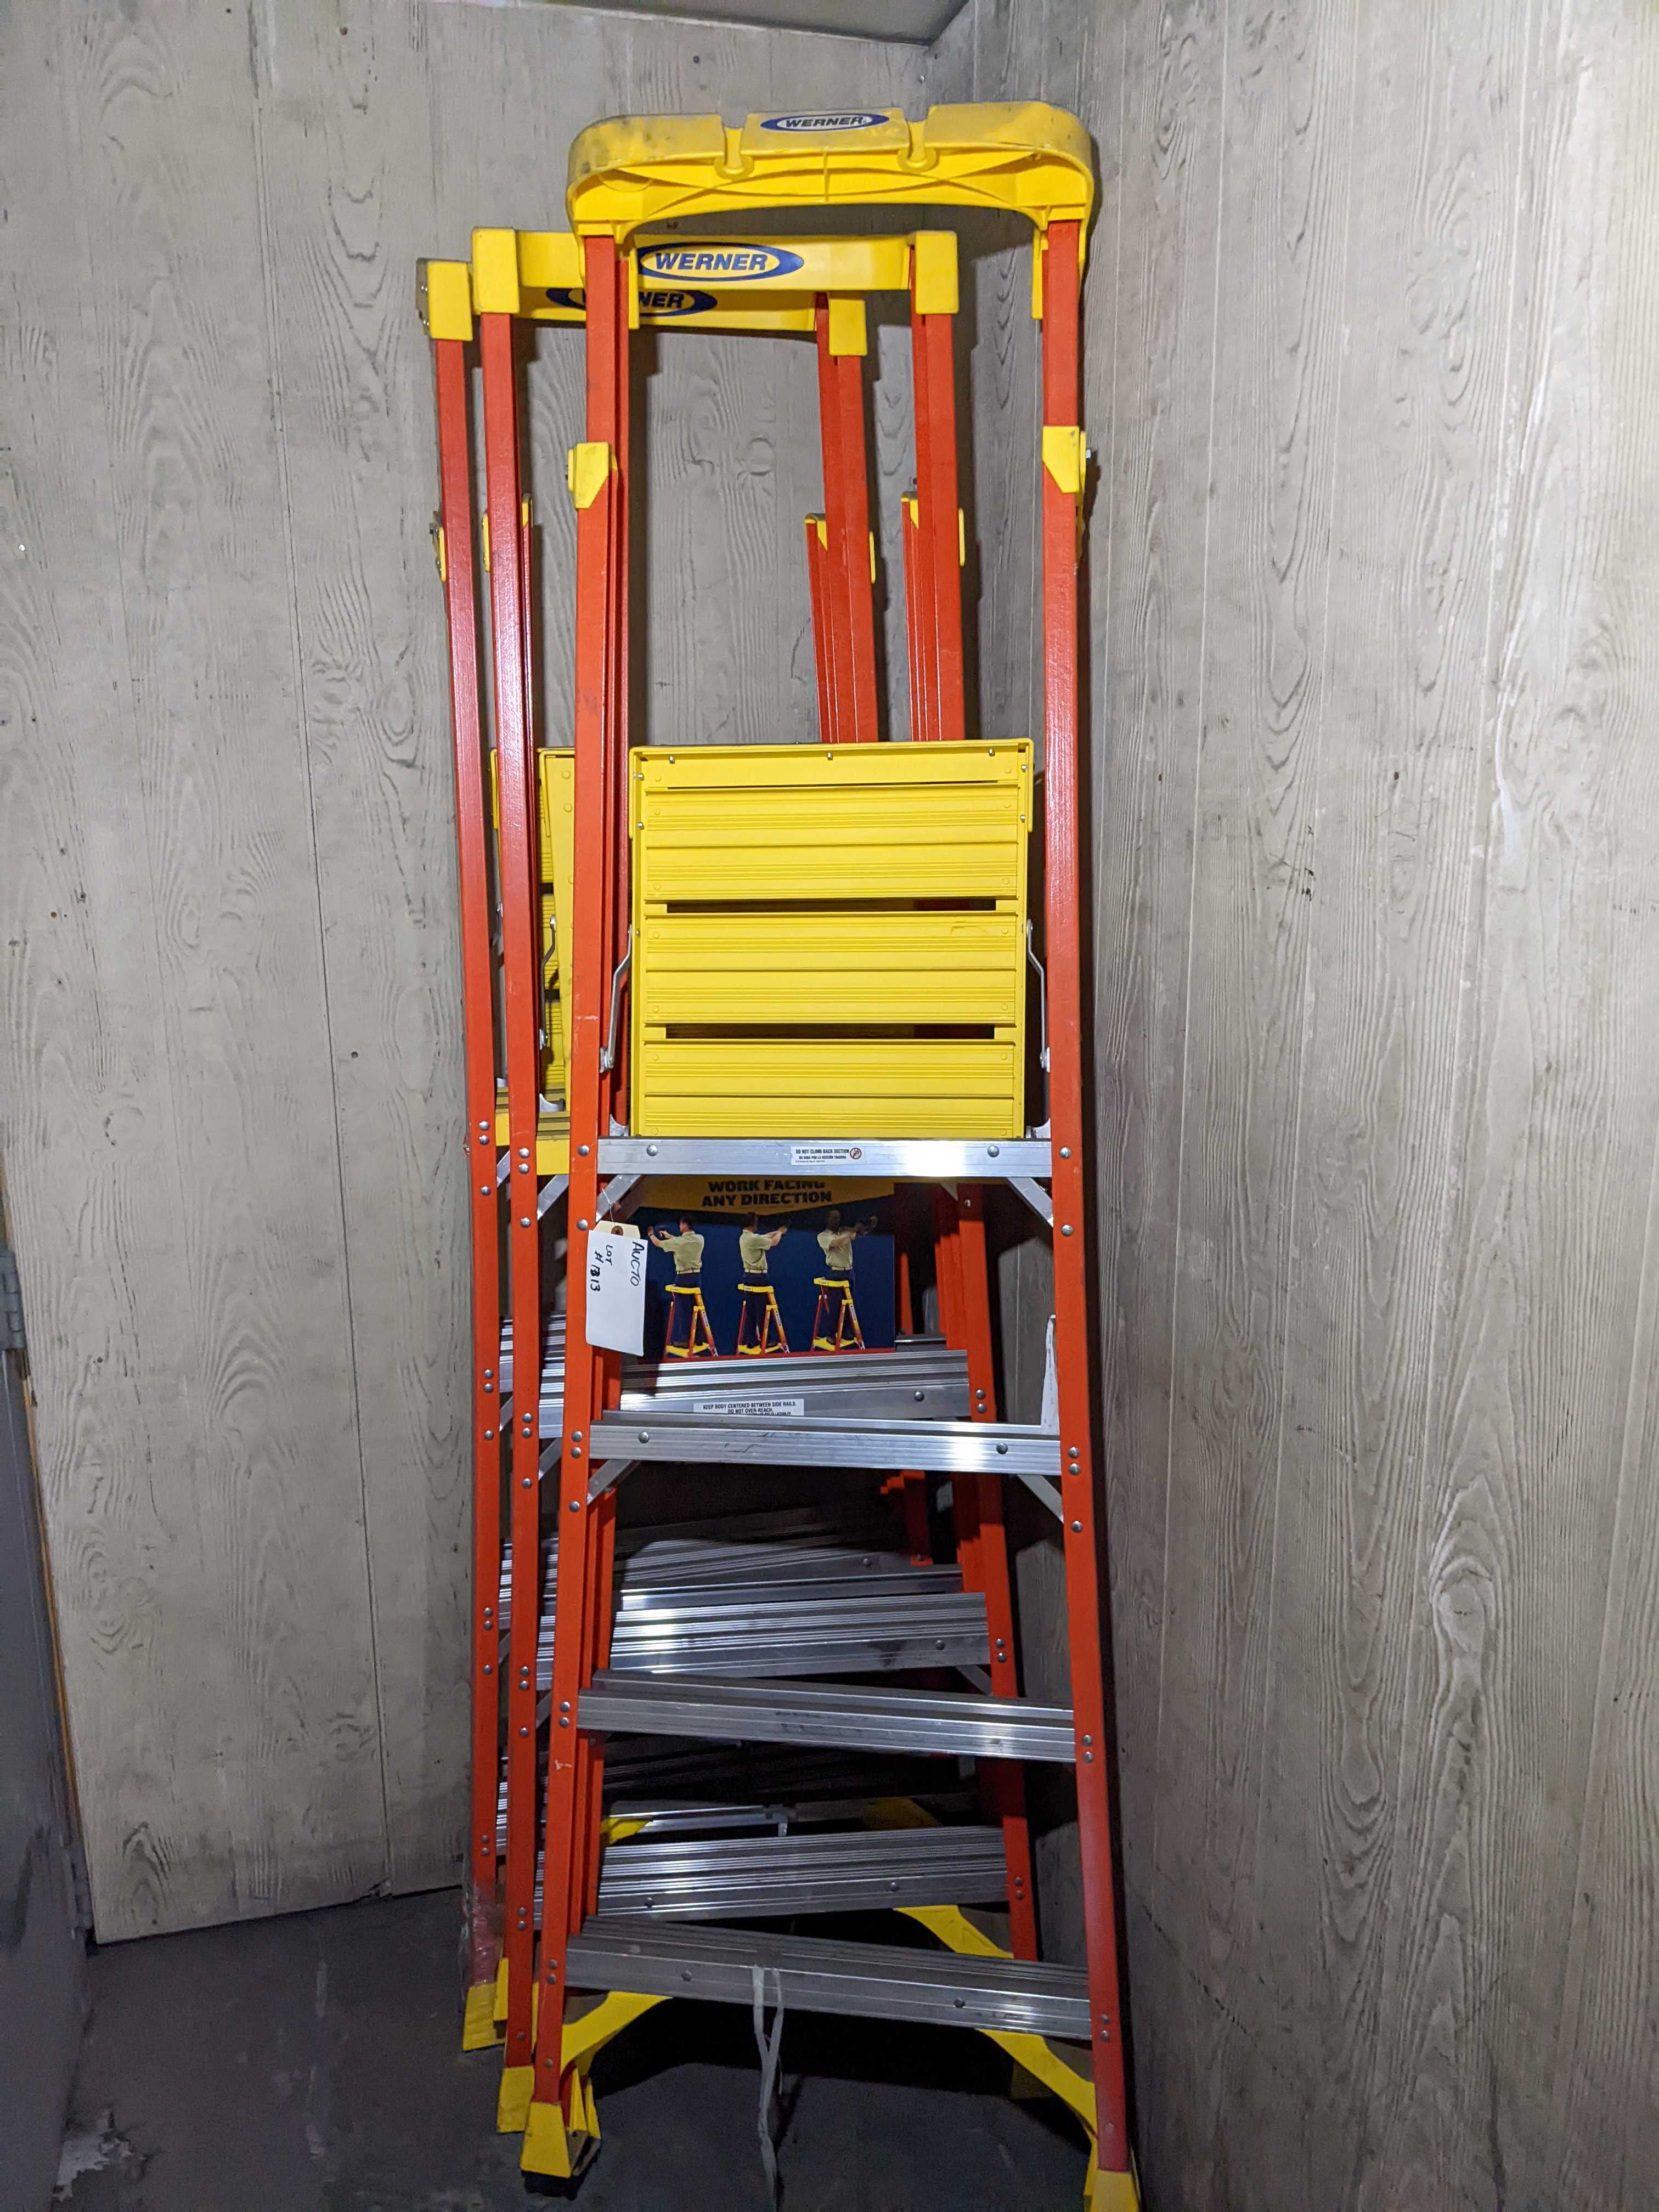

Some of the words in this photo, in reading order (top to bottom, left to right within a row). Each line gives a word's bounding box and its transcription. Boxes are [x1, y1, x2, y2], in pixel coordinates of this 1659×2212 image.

[785, 116, 864, 128] WERNER
[655, 253, 768, 271] WERNER
[707, 1180, 760, 1192] WORK
[702, 1194, 737, 1206] ANY
[741, 1191, 832, 1206] DIRECTION
[605, 1245, 613, 1266] LOT
[630, 1241, 645, 1286] AUCTO
